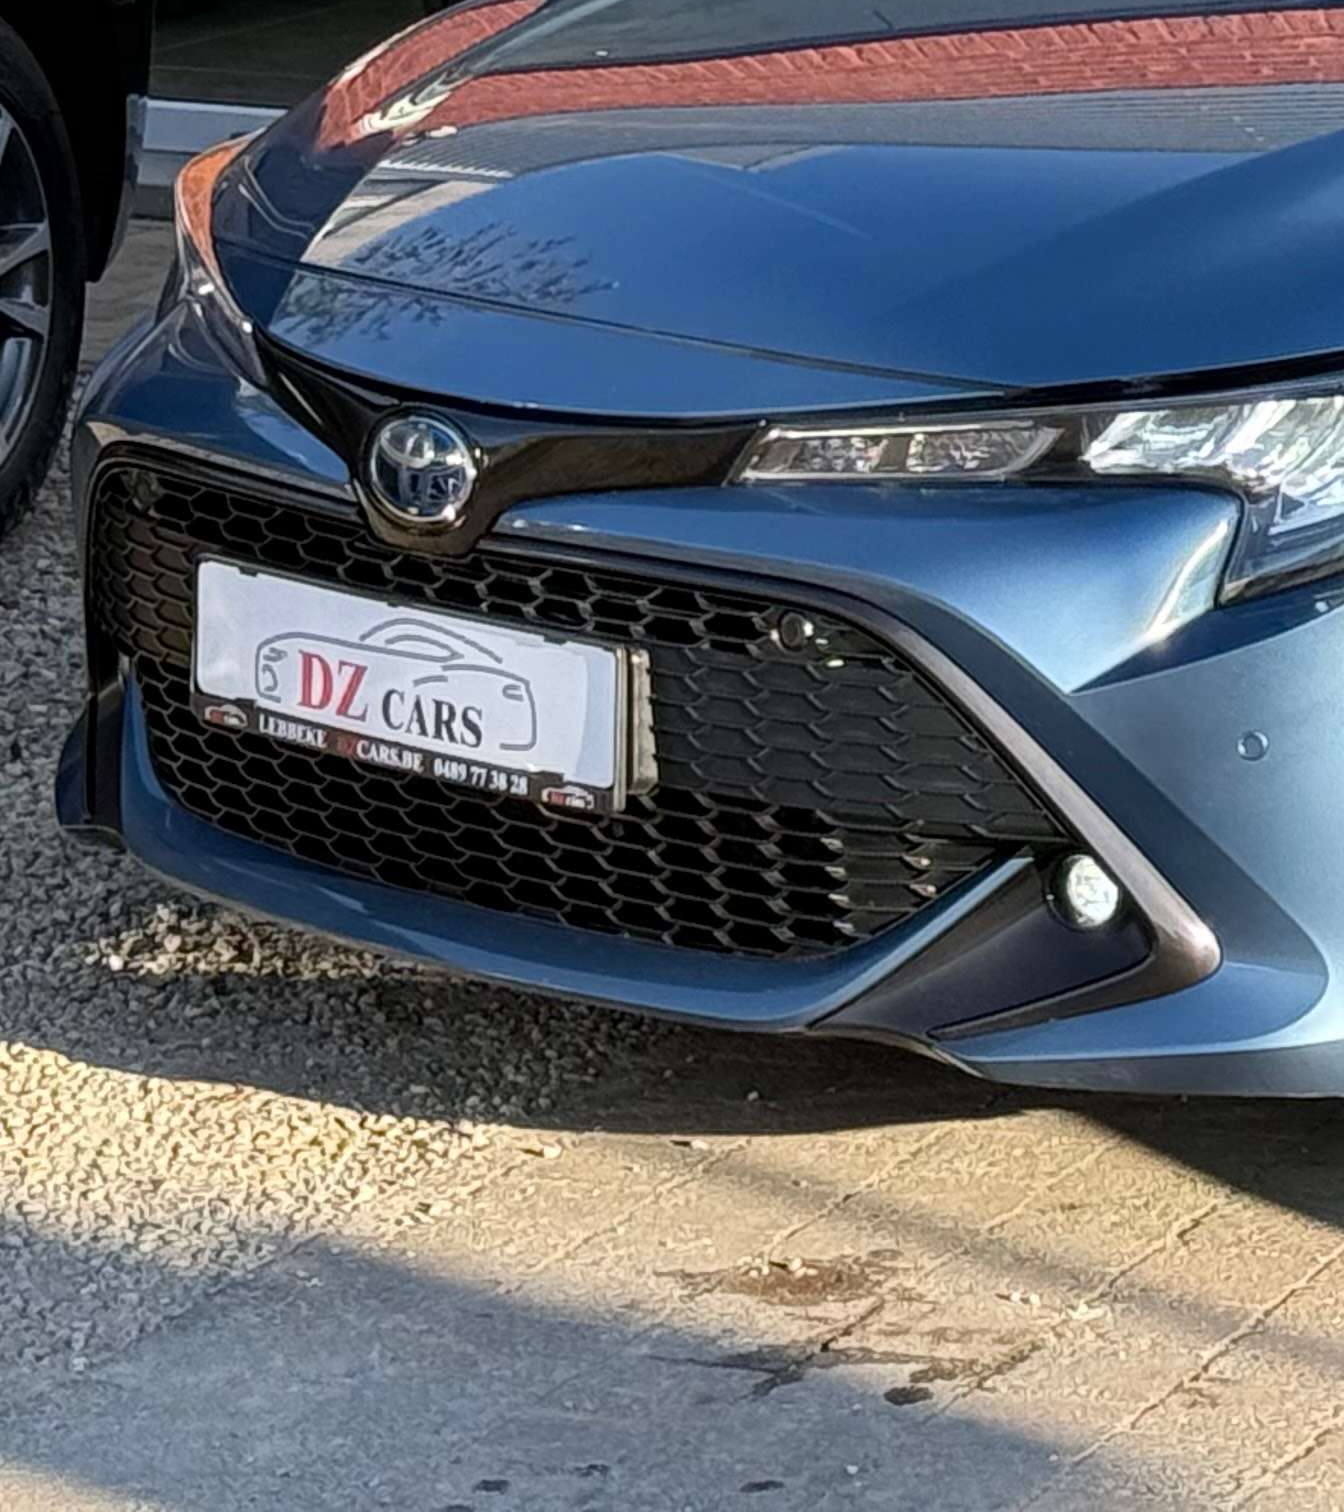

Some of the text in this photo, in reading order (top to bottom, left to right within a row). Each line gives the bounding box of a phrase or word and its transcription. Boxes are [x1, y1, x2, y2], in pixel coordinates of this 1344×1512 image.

[298, 649, 483, 749] DZ CARS
[259, 712, 329, 749] LEBBEKE
[433, 757, 467, 783] 0489
[470, 765, 488, 788] 77
